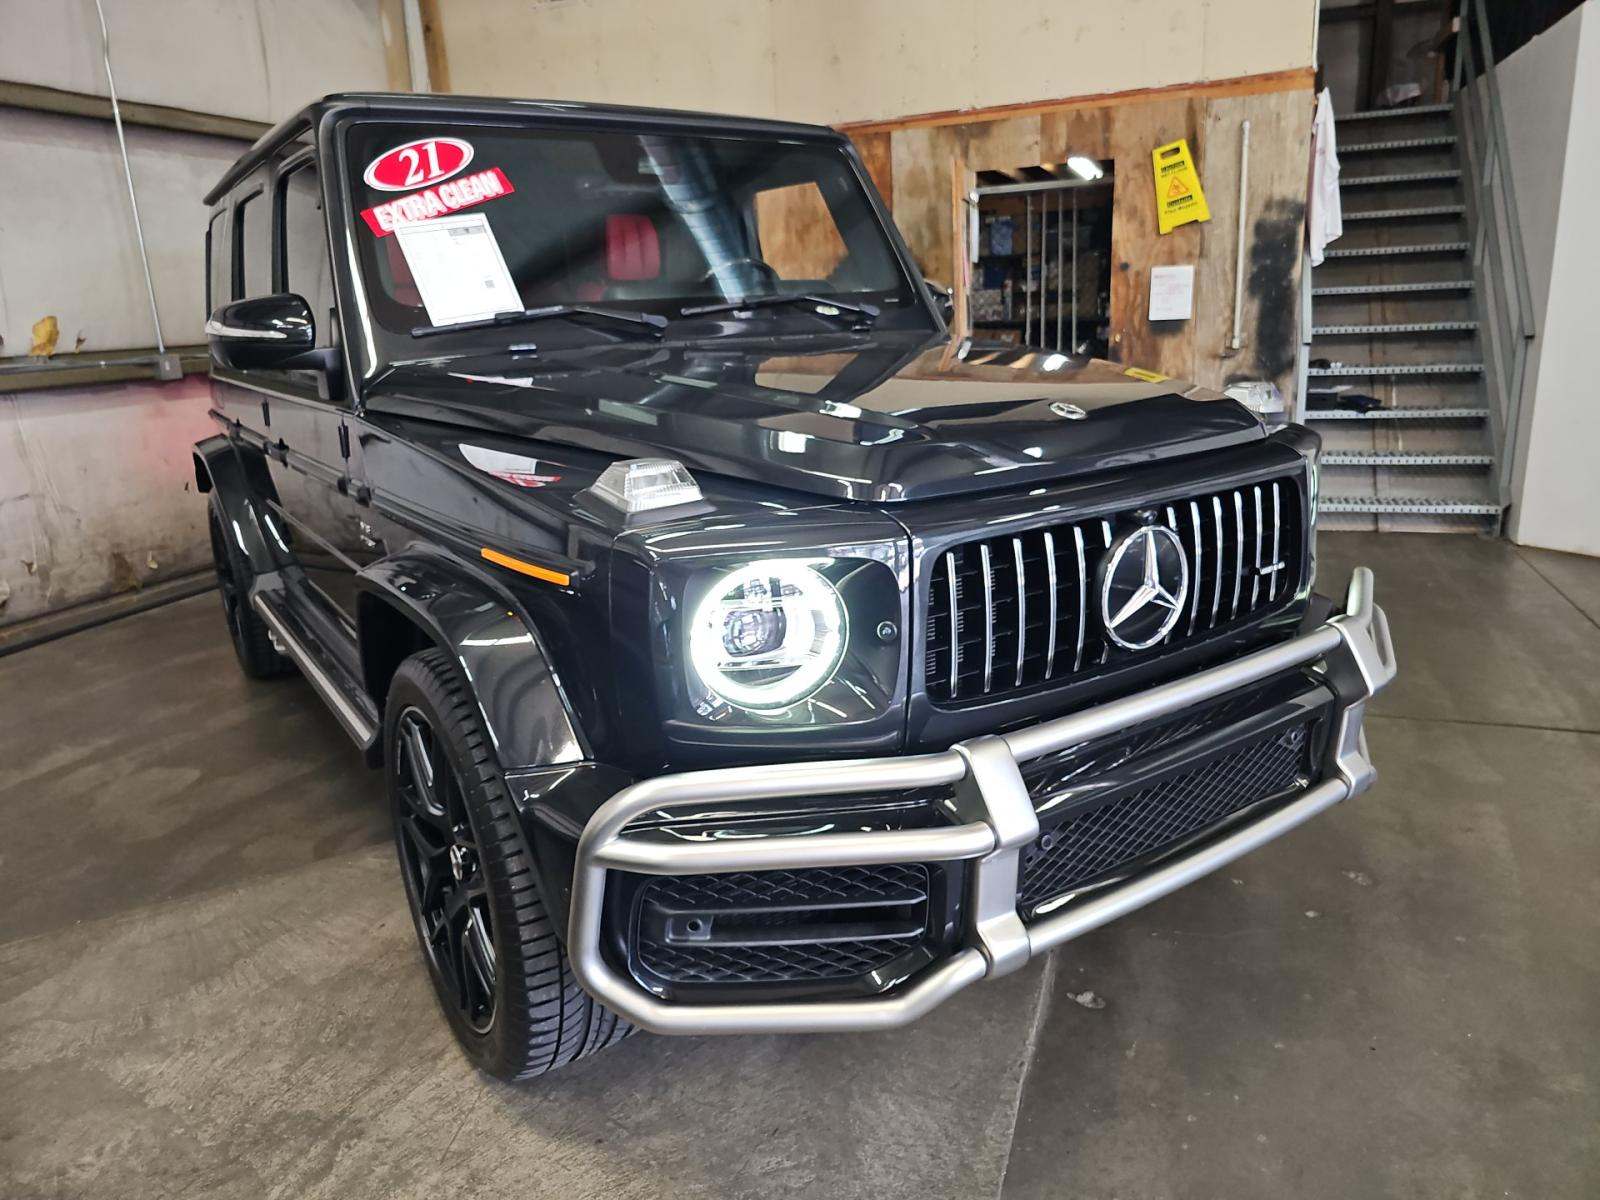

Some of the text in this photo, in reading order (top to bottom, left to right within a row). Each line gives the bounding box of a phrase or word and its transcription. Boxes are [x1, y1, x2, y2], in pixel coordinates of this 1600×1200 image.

[399, 141, 445, 186] 21
[373, 171, 504, 232] EXTRA CLEAN
